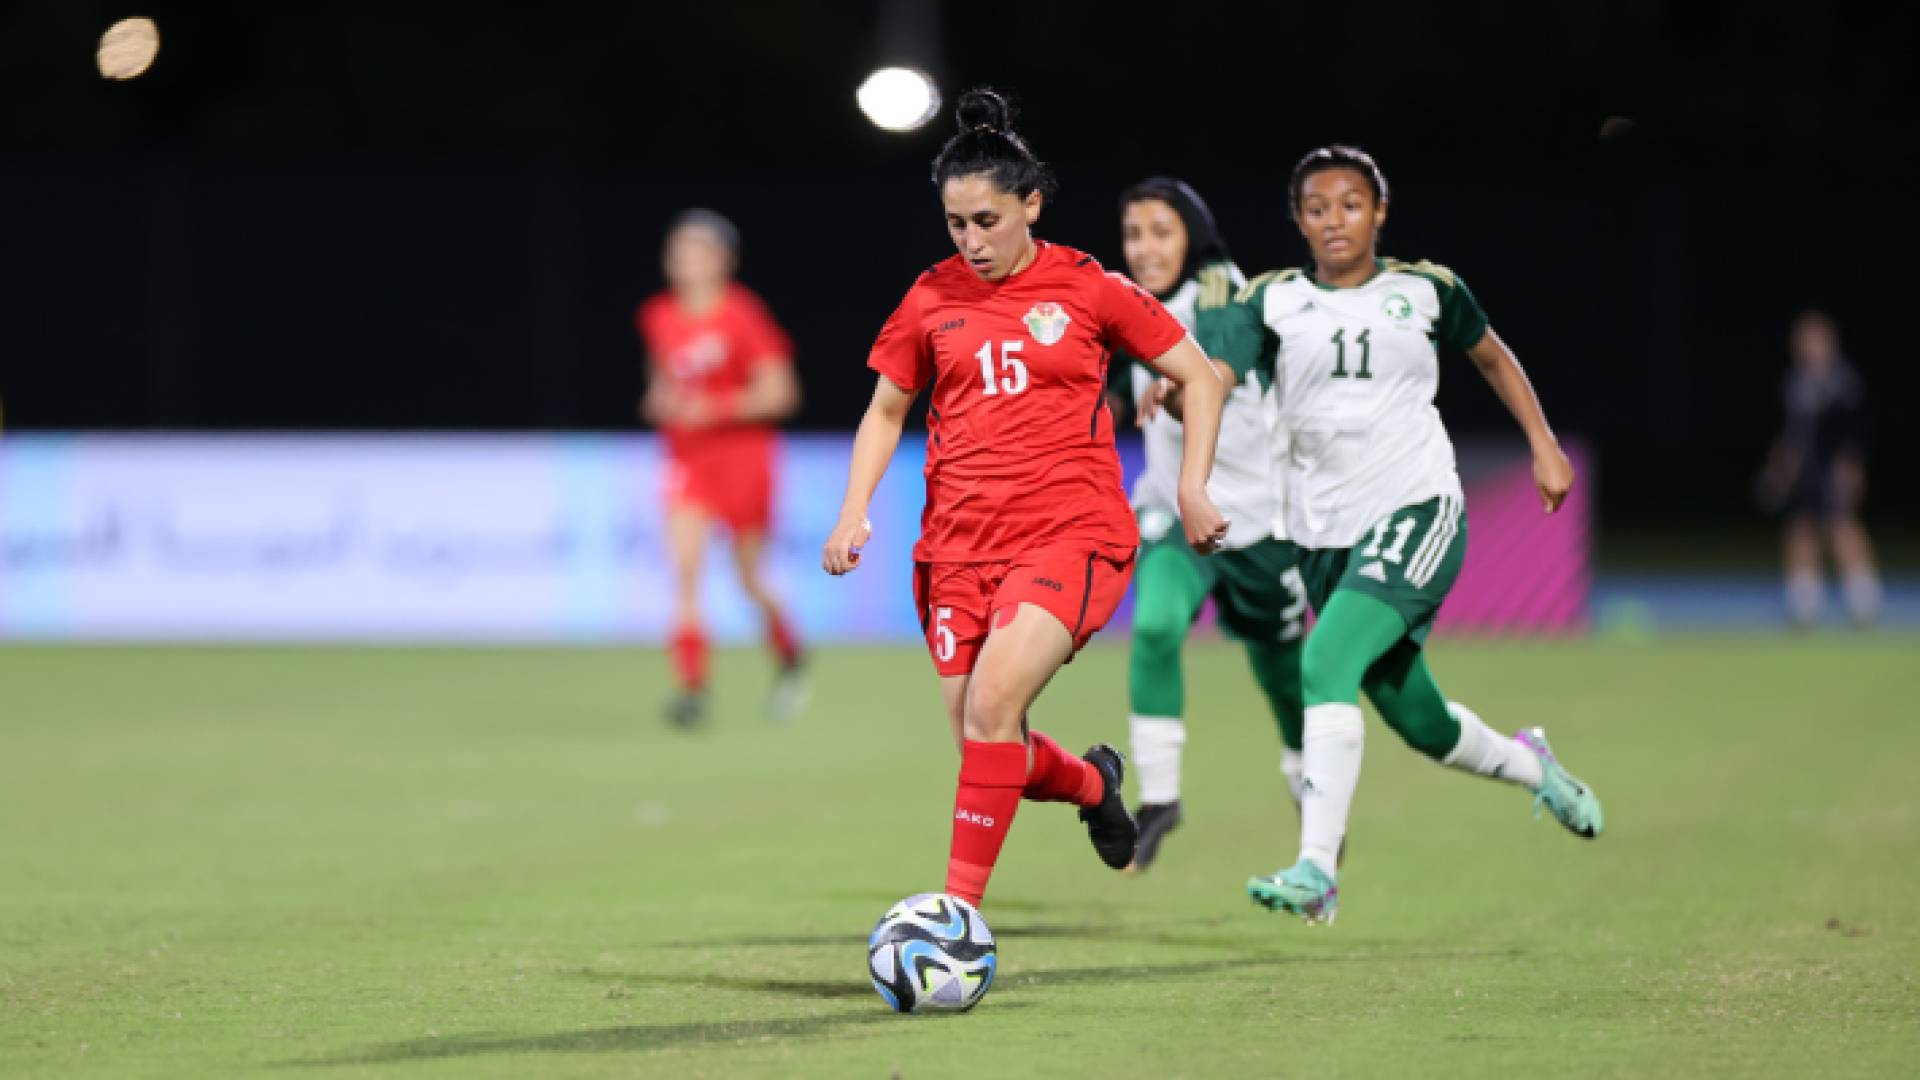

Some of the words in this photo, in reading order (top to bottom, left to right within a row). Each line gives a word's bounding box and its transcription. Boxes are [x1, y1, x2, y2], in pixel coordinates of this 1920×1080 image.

[975, 340, 1029, 395] 15
[1331, 328, 1372, 379] 11
[1360, 516, 1416, 564] 11
[955, 807, 994, 827] JAKO
